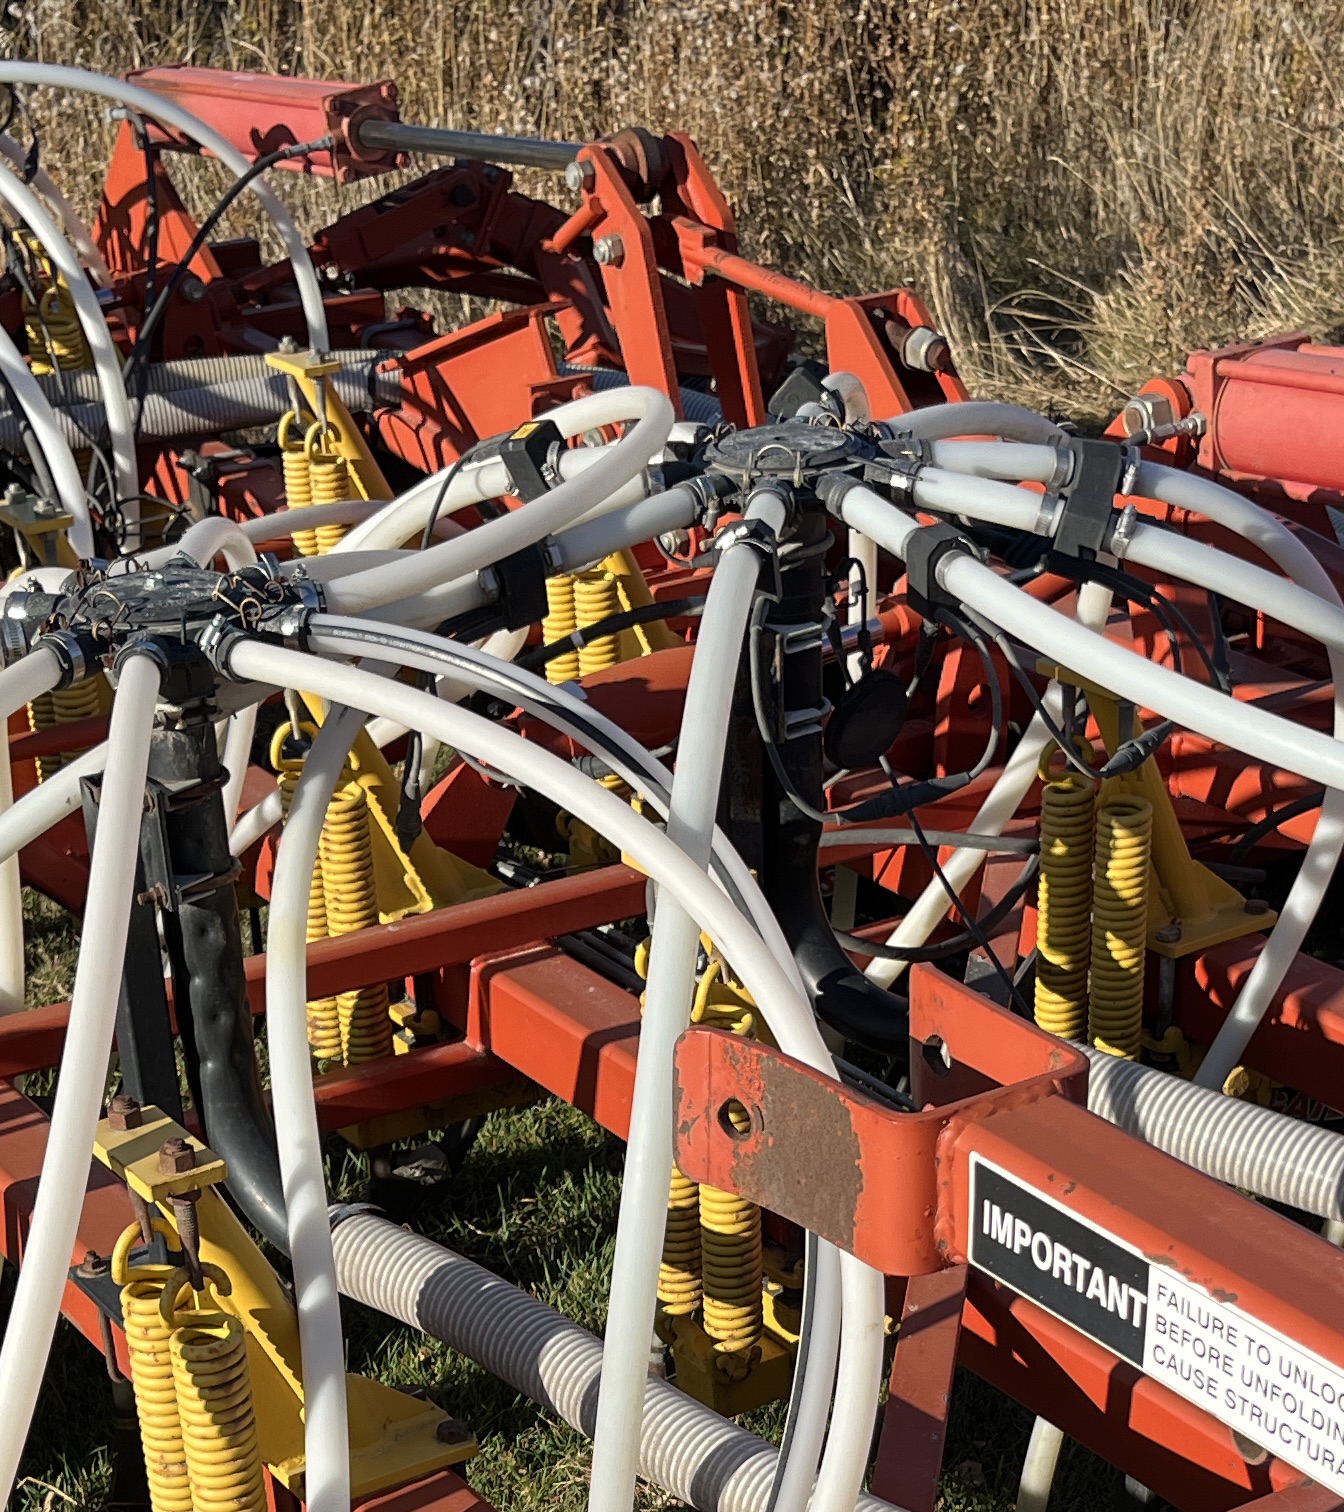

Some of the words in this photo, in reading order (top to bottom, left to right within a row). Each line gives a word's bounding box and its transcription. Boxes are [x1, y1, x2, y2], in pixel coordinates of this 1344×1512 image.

[983, 1199, 1147, 1328] IMPORTANT
[1155, 1313, 1234, 1376] BEFORE
[1157, 1283, 1238, 1347] FAILURE
[1244, 1334, 1271, 1365] TO
[1153, 1344, 1218, 1399] CAUSE
